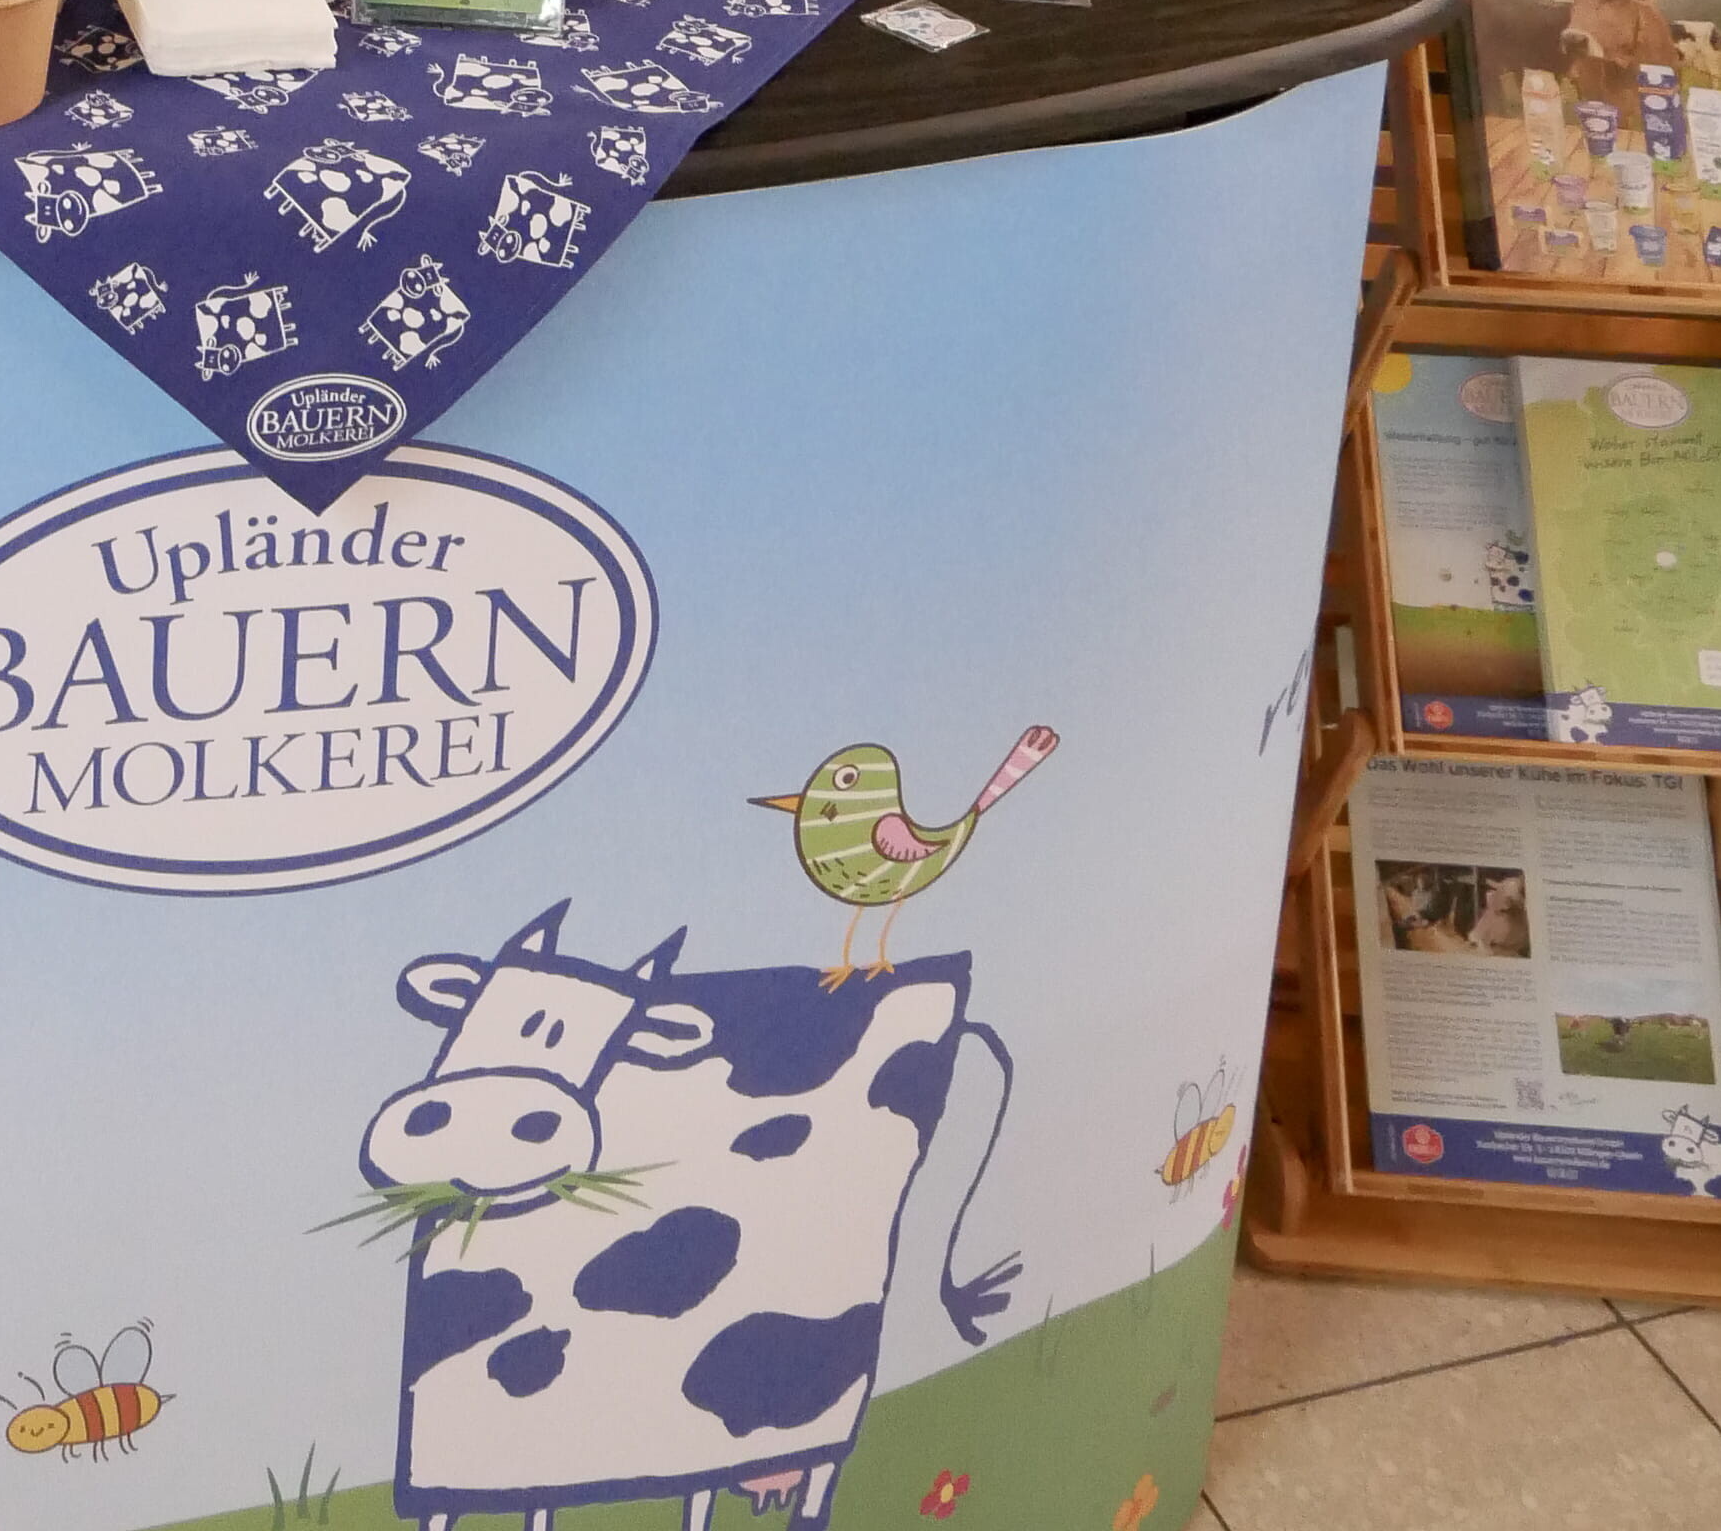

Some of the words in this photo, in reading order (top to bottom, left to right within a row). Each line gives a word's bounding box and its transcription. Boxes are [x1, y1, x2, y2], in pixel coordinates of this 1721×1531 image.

[290, 387, 366, 408] Upländer
[262, 403, 393, 435] BAUERN
[277, 426, 375, 449] MOLKEREI
[92, 500, 466, 605] Upländer
[21, 710, 514, 815] MOLKEREI
[1403, 761, 1444, 774] Wohl
[1449, 764, 1513, 778] unserer
